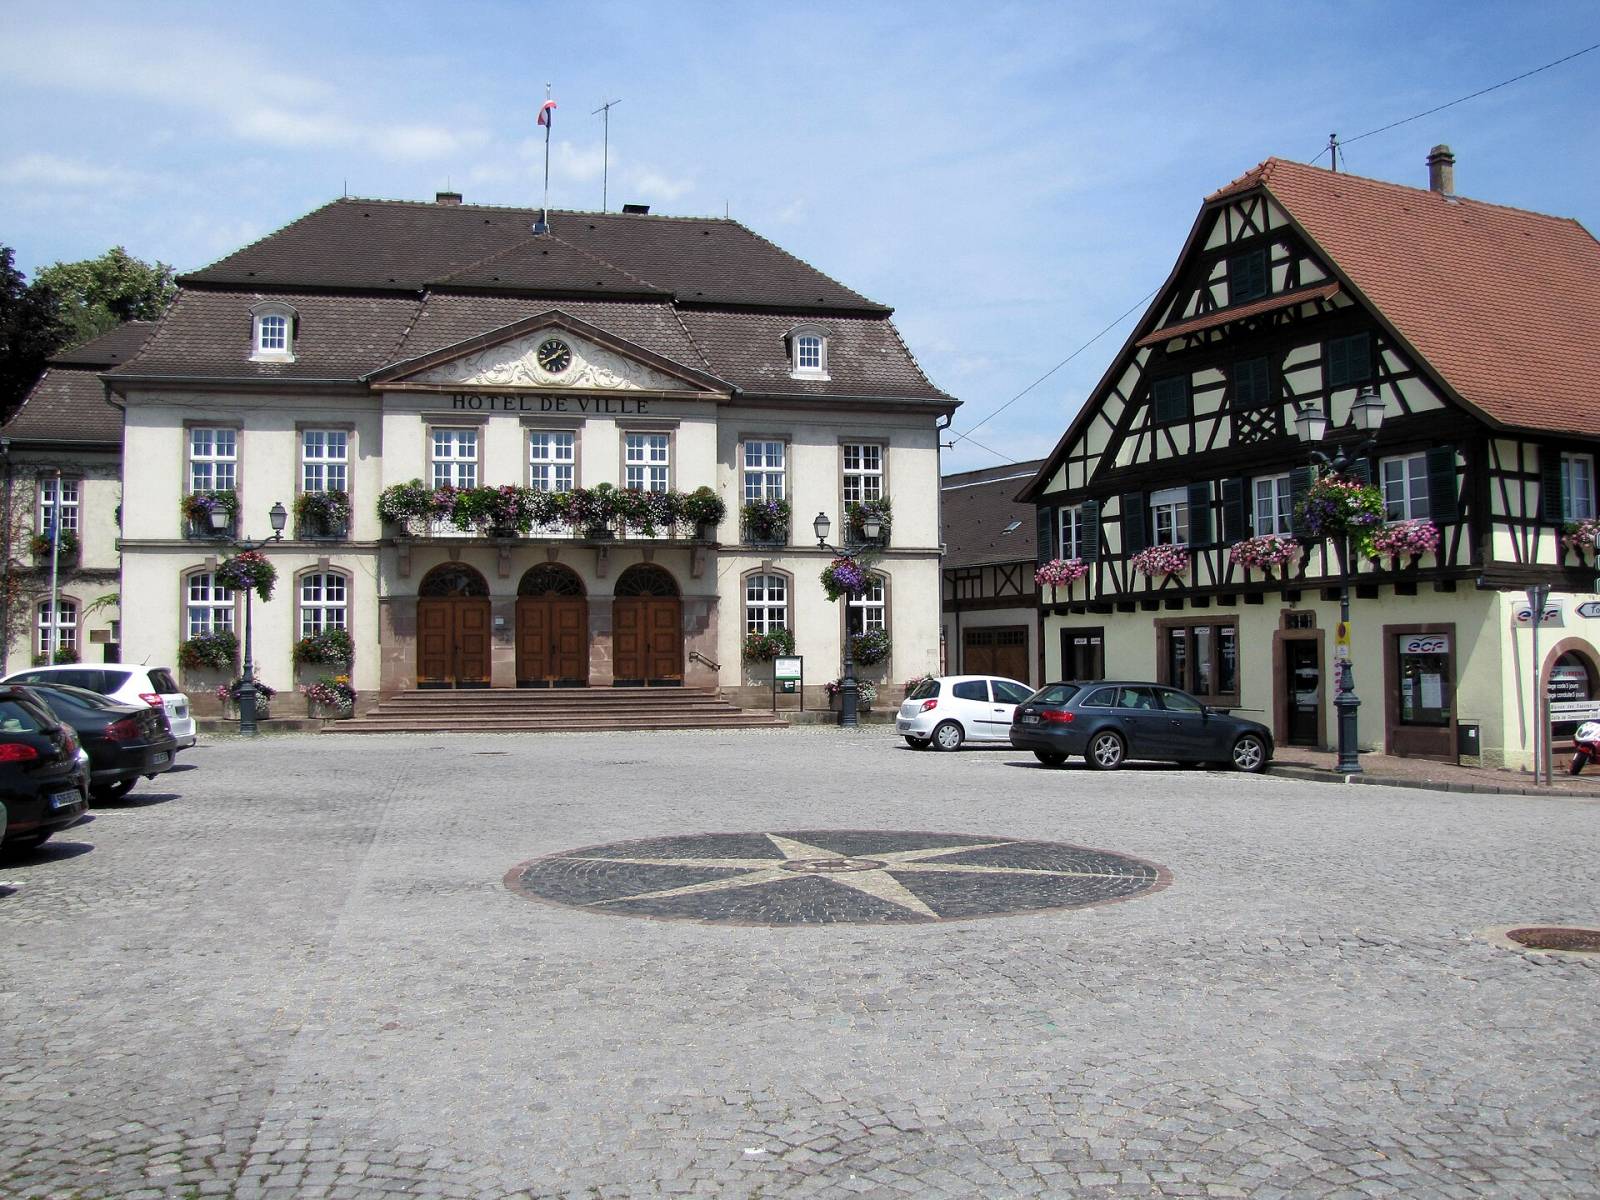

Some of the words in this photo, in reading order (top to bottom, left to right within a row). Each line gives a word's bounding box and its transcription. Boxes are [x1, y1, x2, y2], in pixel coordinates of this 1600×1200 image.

[453, 395, 531, 411] HOTEL
[540, 397, 568, 412] DE
[577, 398, 649, 414] VILLE
